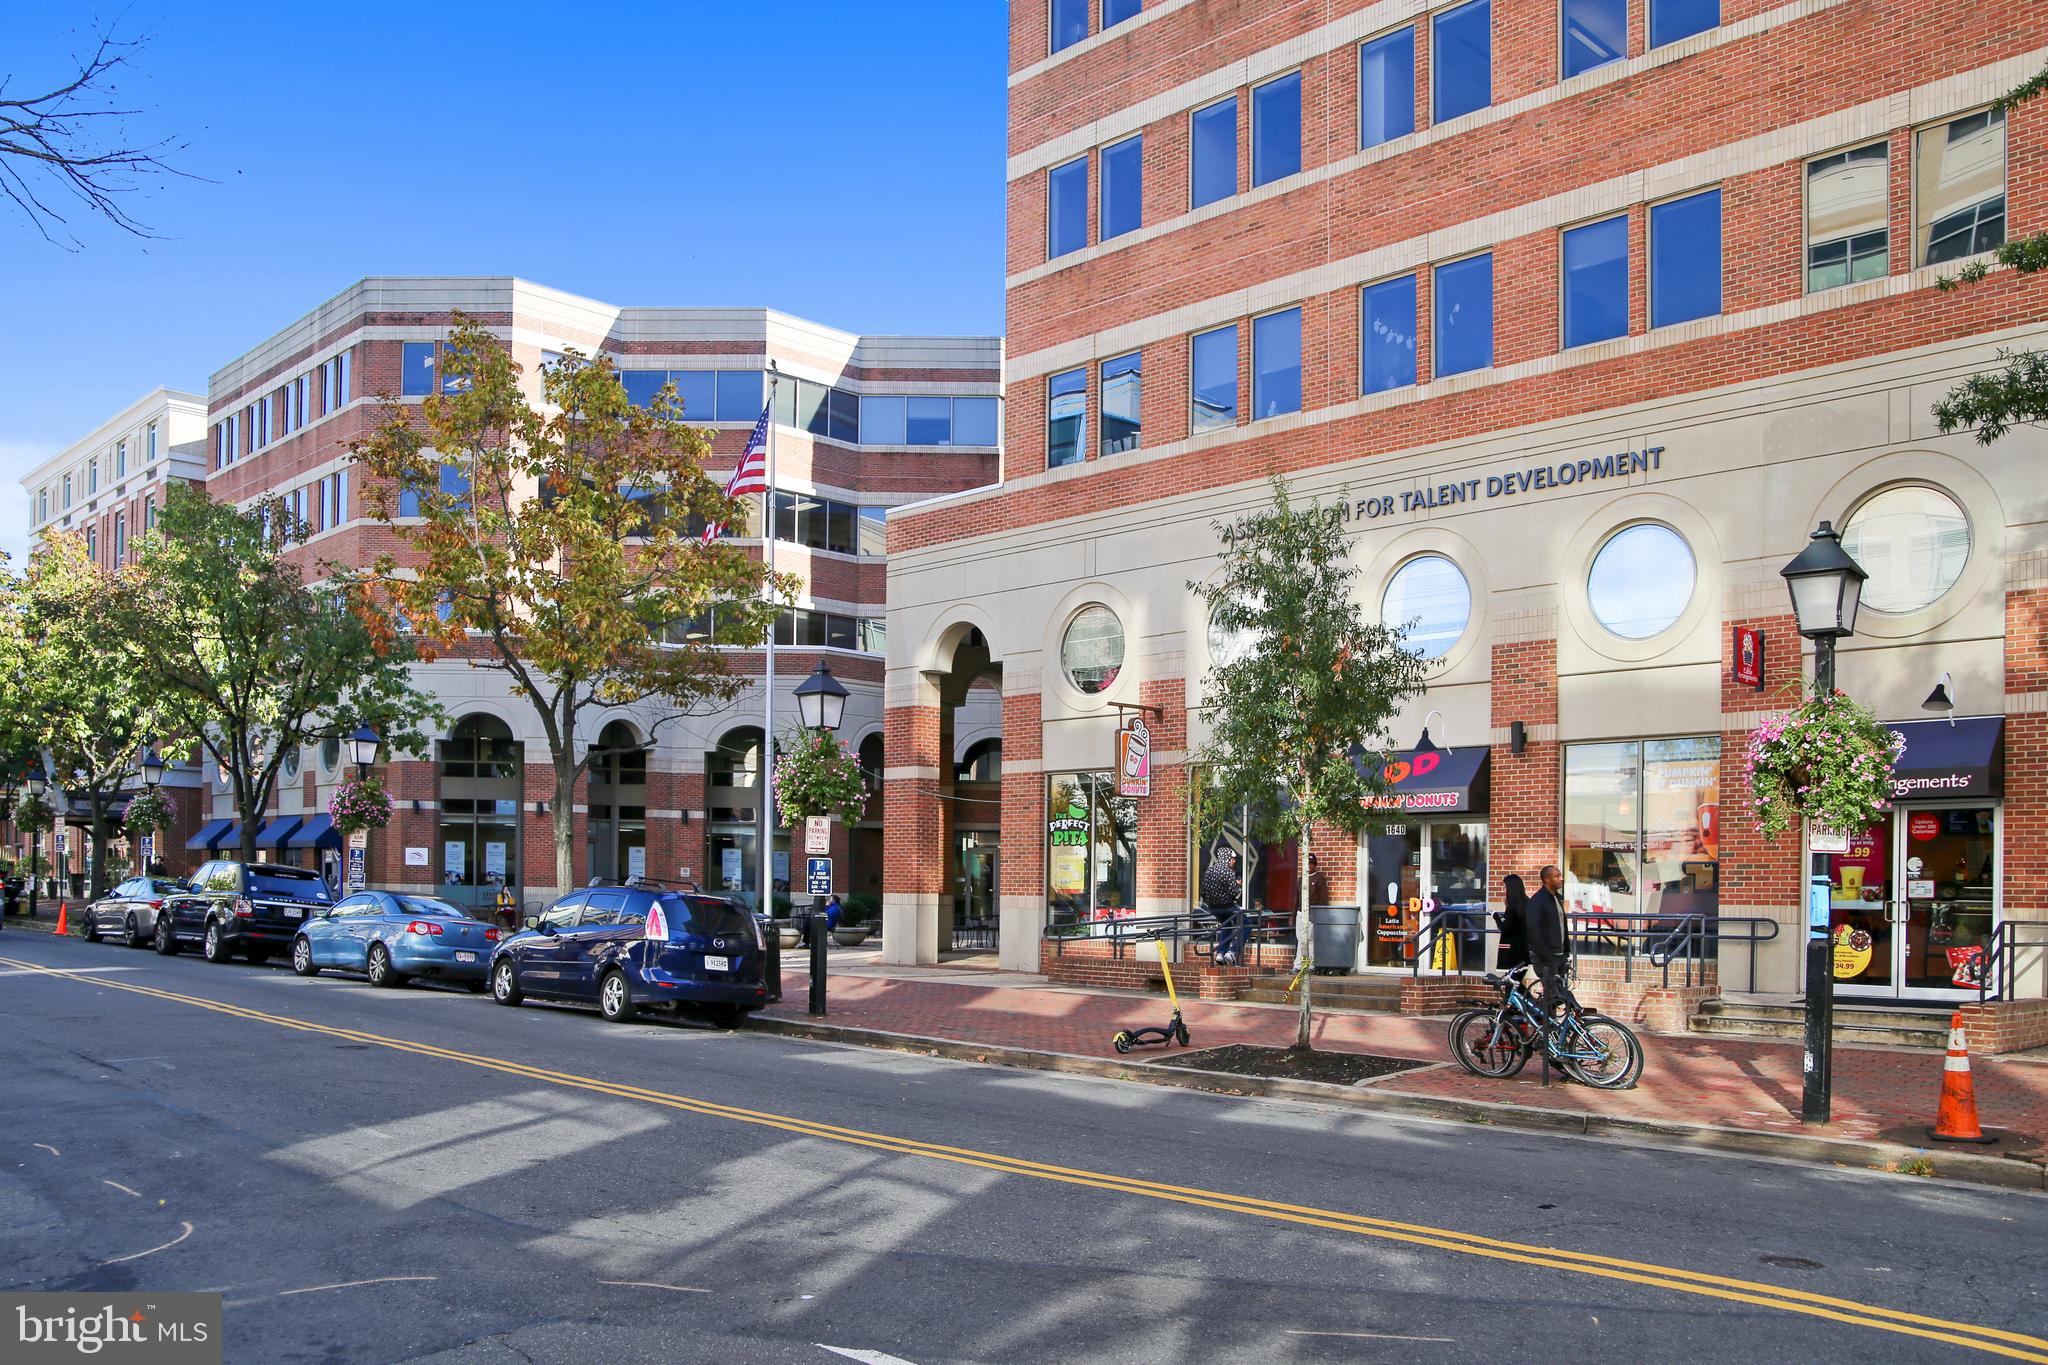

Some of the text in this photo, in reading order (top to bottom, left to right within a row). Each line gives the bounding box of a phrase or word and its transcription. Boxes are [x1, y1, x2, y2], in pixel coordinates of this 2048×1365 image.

[1355, 495, 1394, 521] FOR
[1402, 479, 1481, 512] TALENT
[1486, 447, 1665, 498] DEVELOPMENT
[1121, 785, 1147, 794] DONUTS
[1405, 792, 1459, 808] DONUTS
[1048, 819, 1090, 832] PERFECT
[1386, 824, 1406, 835] 1640
[1811, 823, 1846, 837] PARKG
[1843, 847, 1870, 857] .99
[815, 860, 824, 870] P
[1409, 897, 1435, 913] DD
